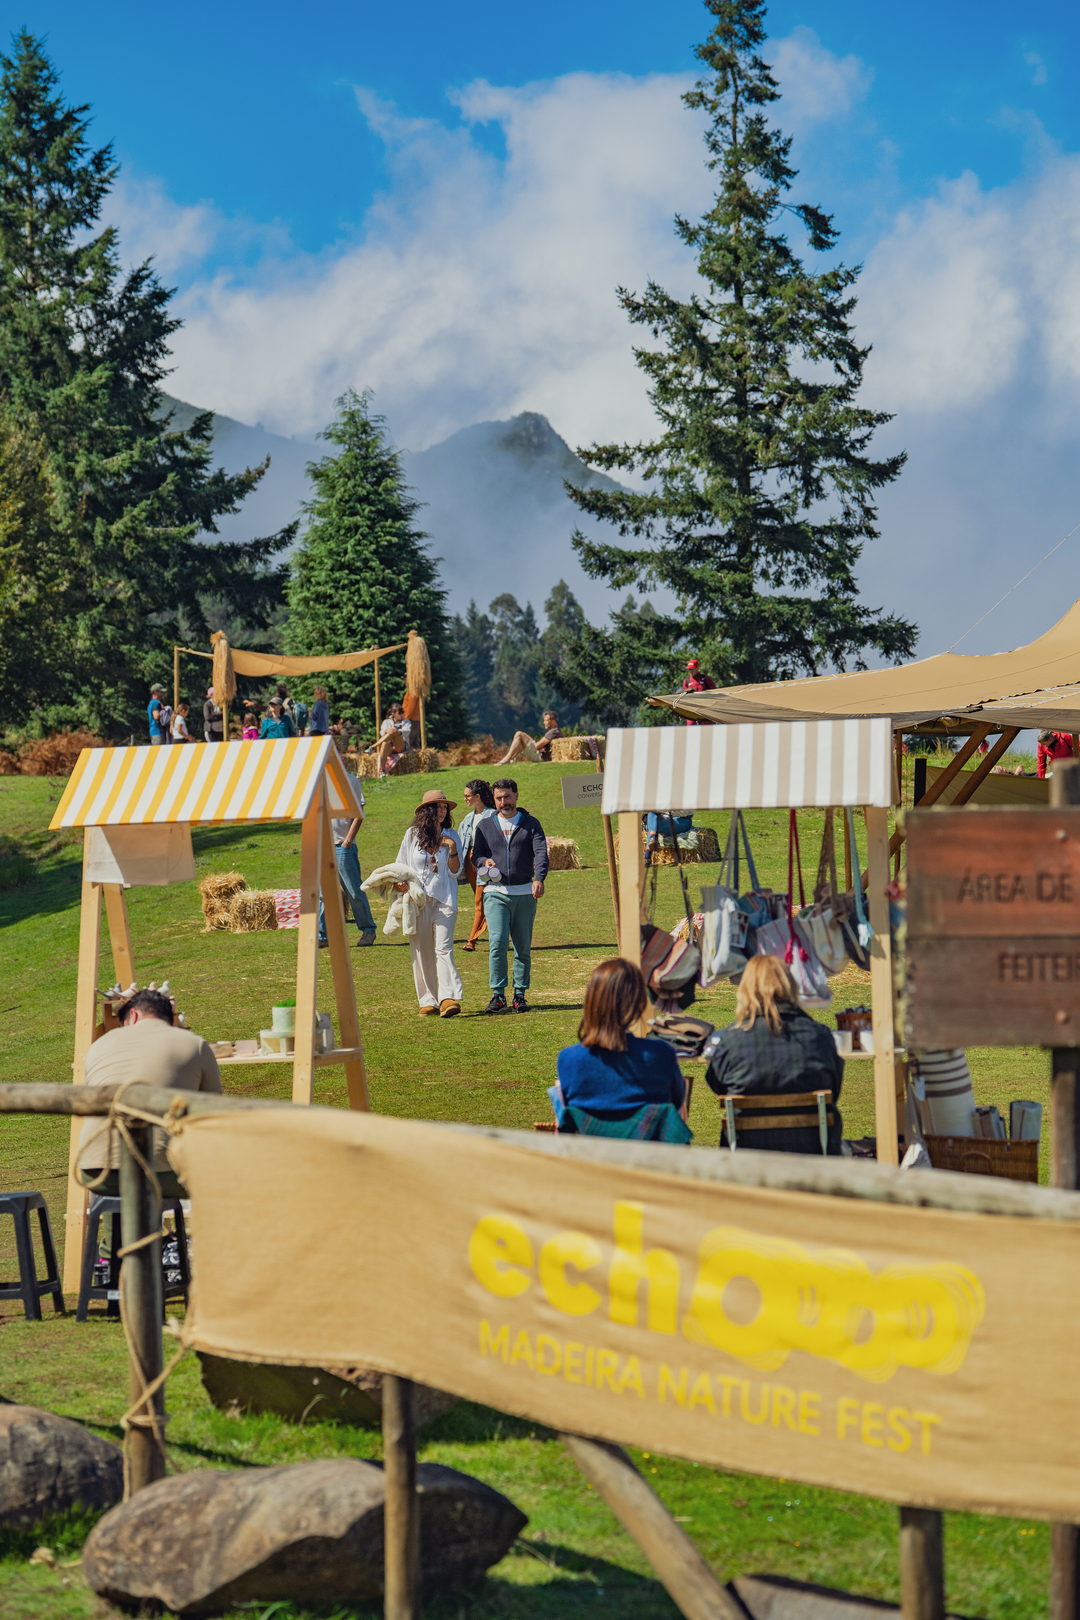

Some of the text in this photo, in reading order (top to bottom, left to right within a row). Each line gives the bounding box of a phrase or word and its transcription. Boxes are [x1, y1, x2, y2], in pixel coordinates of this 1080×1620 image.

[957, 865, 1074, 904] ÁREA DE
[478, 1319, 942, 1455] MADEIRA NATURE FEST
